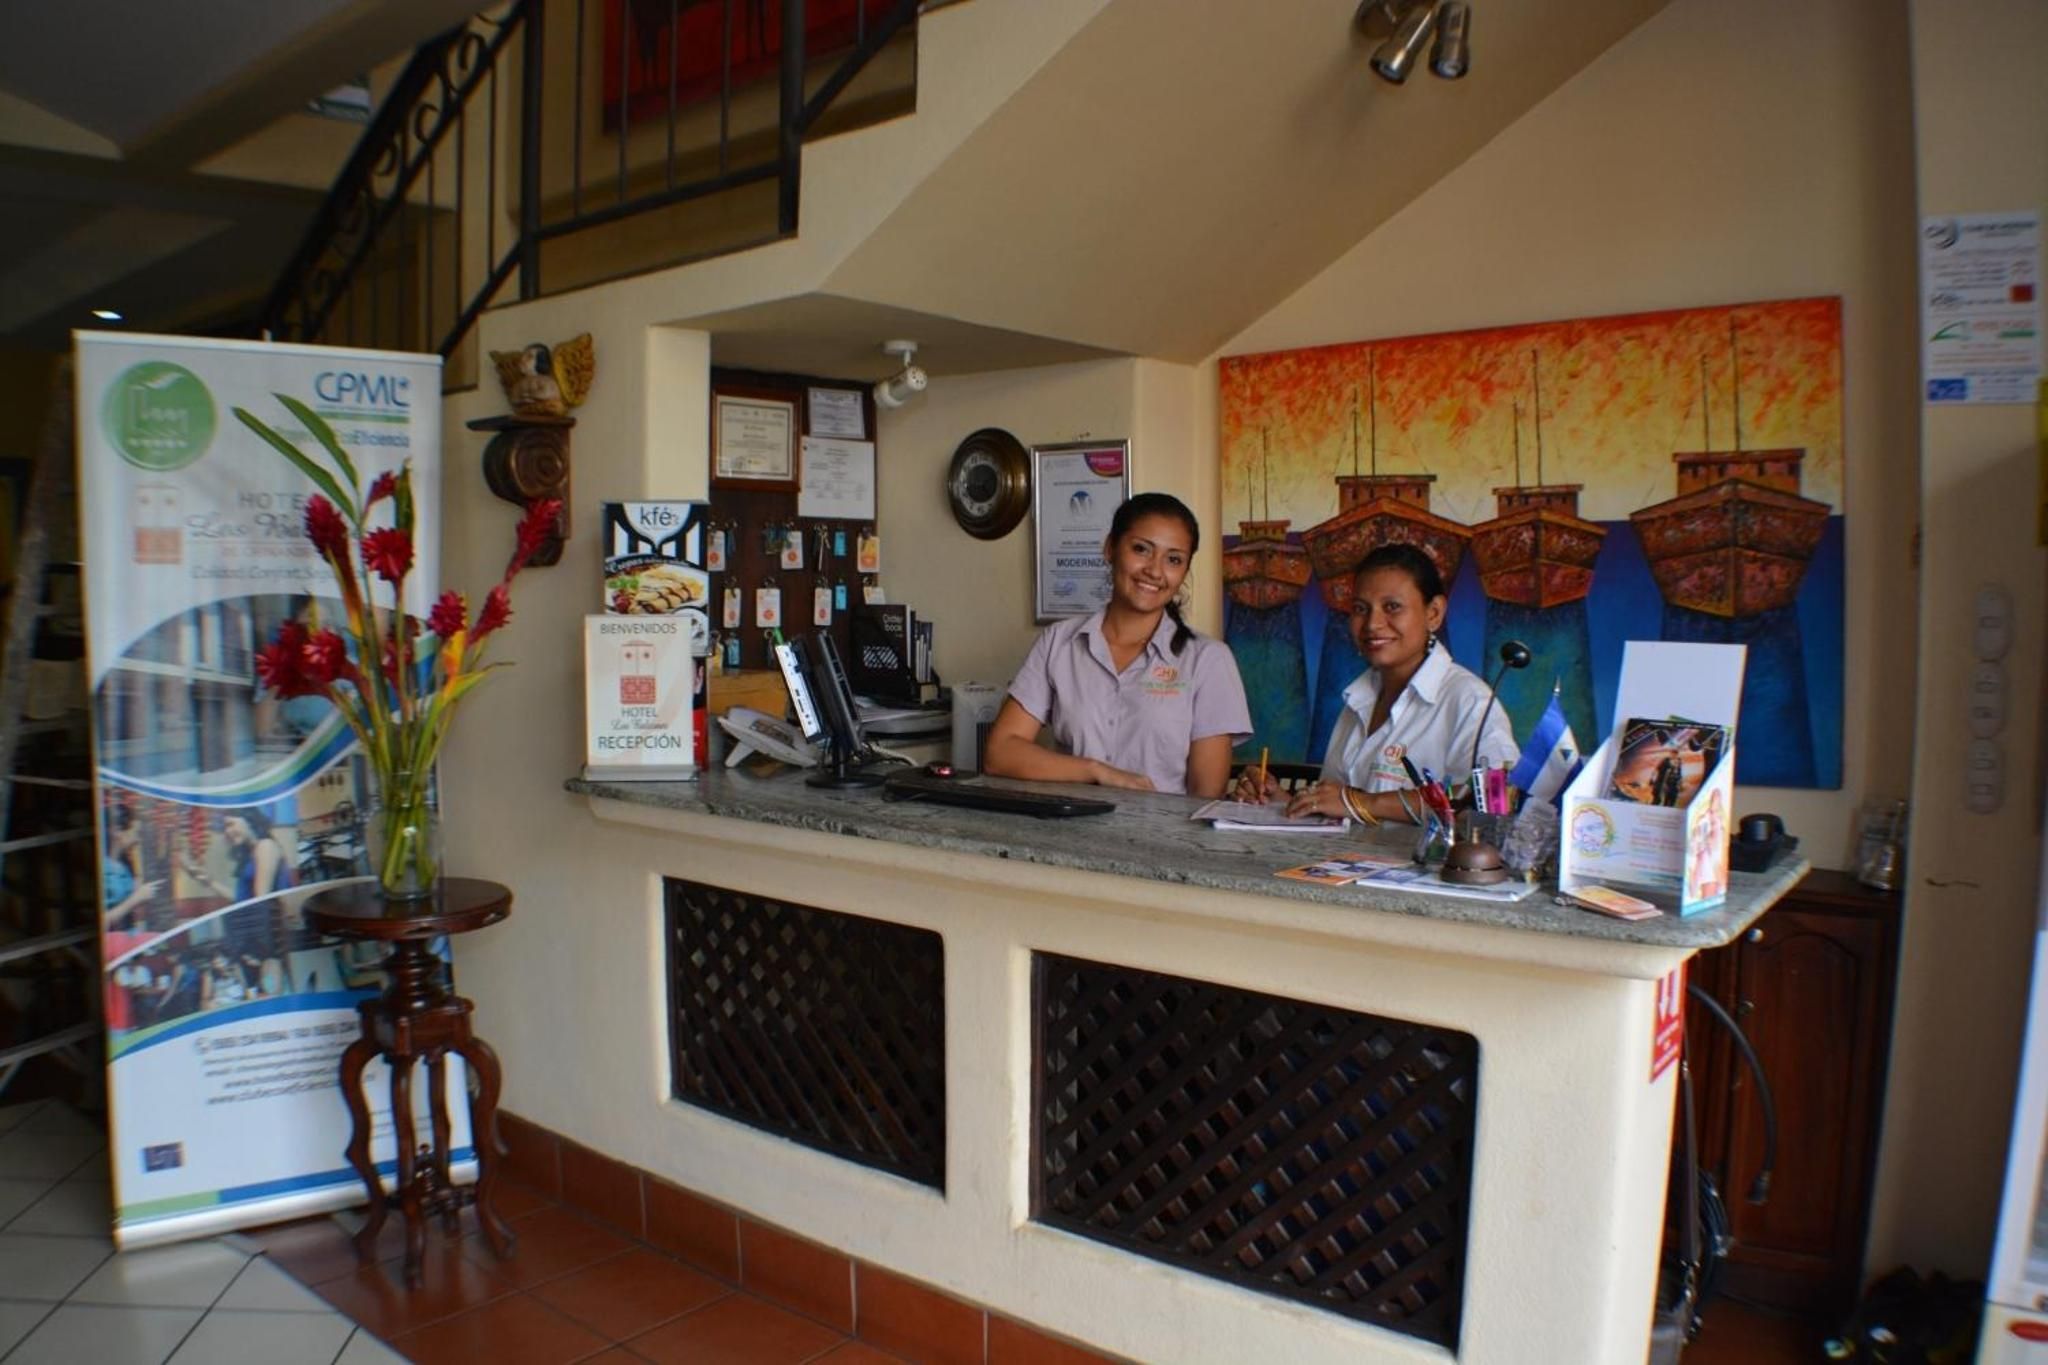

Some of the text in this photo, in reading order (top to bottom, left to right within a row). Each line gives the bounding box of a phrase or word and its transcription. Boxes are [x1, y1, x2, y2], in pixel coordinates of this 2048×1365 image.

[240, 492, 304, 509] HOTE
[1056, 558, 1107, 569] MODERNIZA
[600, 622, 677, 635] BIENVENIDOS
[621, 707, 658, 718] HOTEL
[598, 733, 682, 749] RECEPCIÓN
